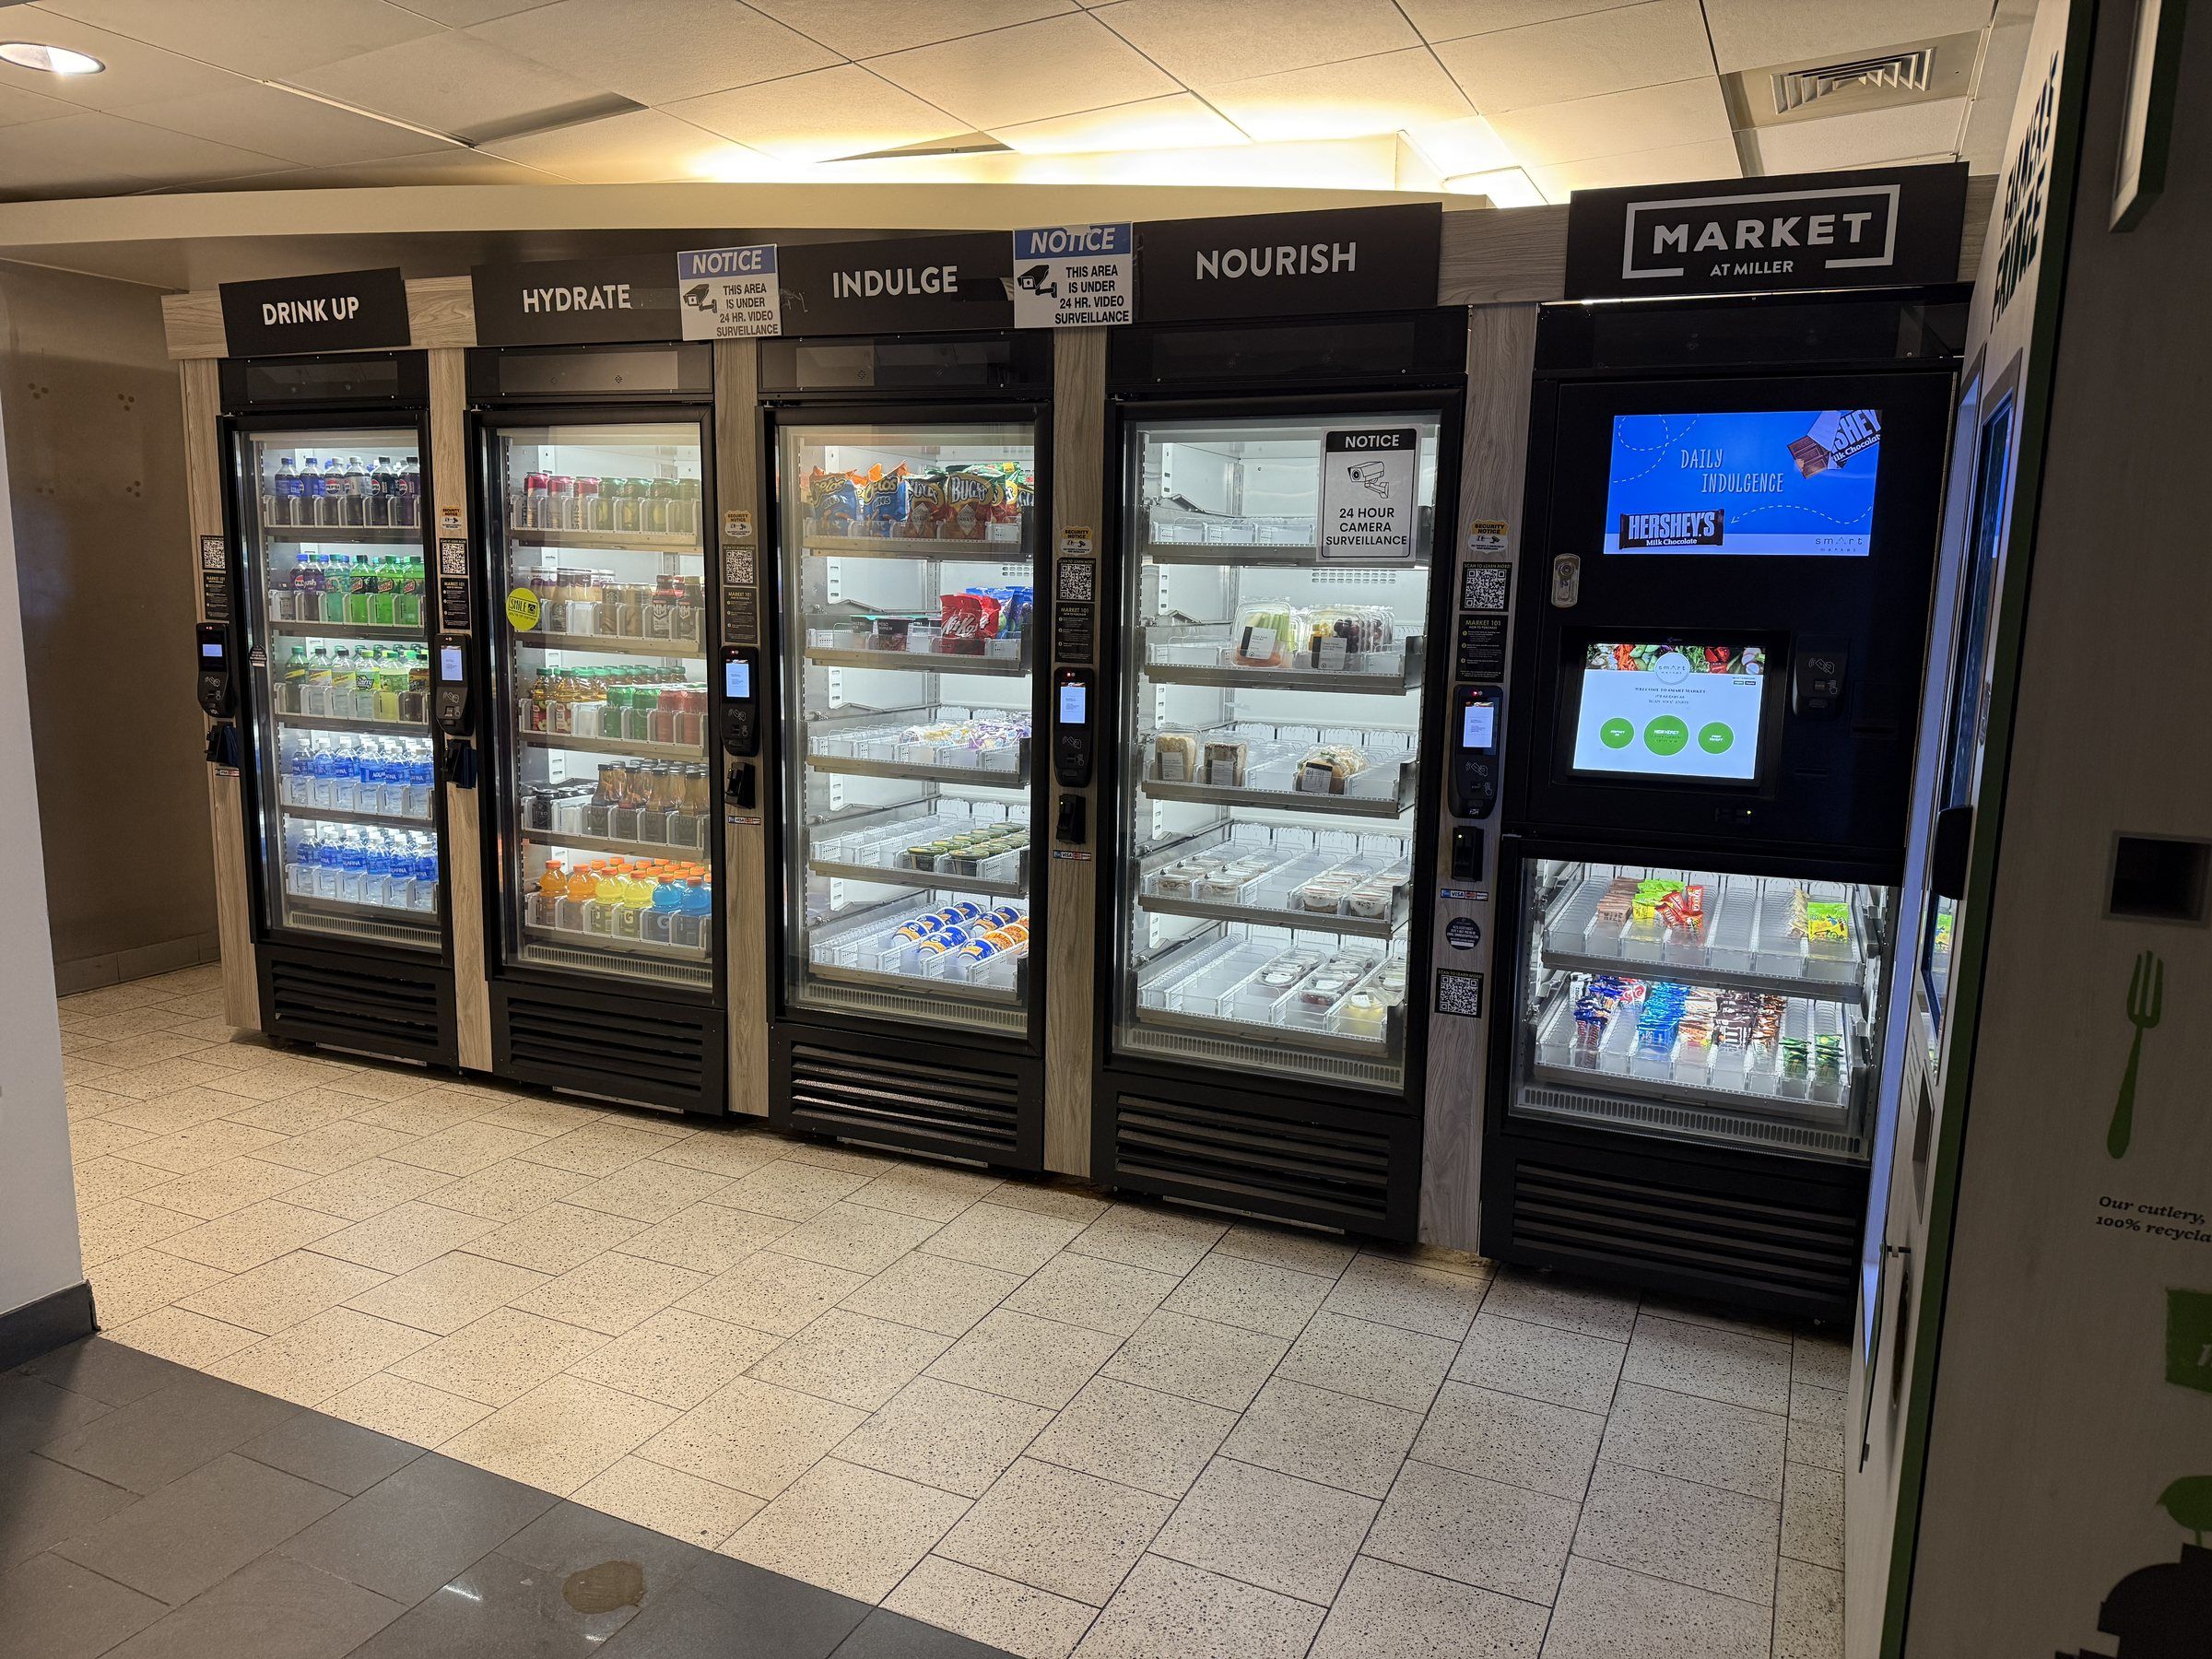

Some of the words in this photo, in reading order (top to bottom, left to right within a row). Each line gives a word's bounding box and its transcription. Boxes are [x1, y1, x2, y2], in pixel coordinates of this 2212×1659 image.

[1653, 211, 1873, 254] MARKET
[1030, 227, 1116, 254] NOTICE
[692, 249, 762, 275] NOTICE
[1195, 241, 1358, 280] NOURISH
[1065, 265, 1088, 278] THIS
[1090, 265, 1118, 276] AREA
[1710, 264, 1731, 276] AT
[1733, 260, 1794, 276] MILLER
[723, 284, 742, 295] THIS
[744, 283, 767, 294] AREA
[832, 265, 959, 299] INDULGE
[1068, 281, 1078, 293] IS
[1080, 280, 1116, 293] UNDER
[522, 284, 633, 313] HYDRATE
[726, 299, 735, 309] IS
[735, 297, 766, 308] UNDER
[1059, 298, 1071, 309] 24
[1074, 297, 1091, 308] HR.
[1093, 295, 1124, 308] VIDEO
[262, 300, 329, 325] DRINK
[331, 296, 359, 320] UP
[719, 313, 730, 323] 24
[732, 312, 747, 322] HR.
[747, 310, 773, 322] VIDEO
[1054, 311, 1130, 324] SURVEILLANCE
[716, 324, 779, 336] SURVEILLANCE
[1345, 434, 1400, 448] NOTICE
[1680, 449, 1723, 469] DAILY
[1701, 473, 1784, 493] INDULGENCE
[1339, 508, 1354, 518] 24
[1358, 507, 1394, 518] HOUR
[1339, 522, 1392, 532] CAMERA
[1629, 512, 1715, 539] HERSHEY'S
[1325, 535, 1407, 545] SURVEILLANCE
[1663, 537, 1697, 546] Chocolate
[510, 598, 526, 612] SMILE
[2099, 1196, 2134, 1211] Our
[2137, 1204, 2206, 1226] cutlery,
[2095, 1216, 2141, 1231] 100%
